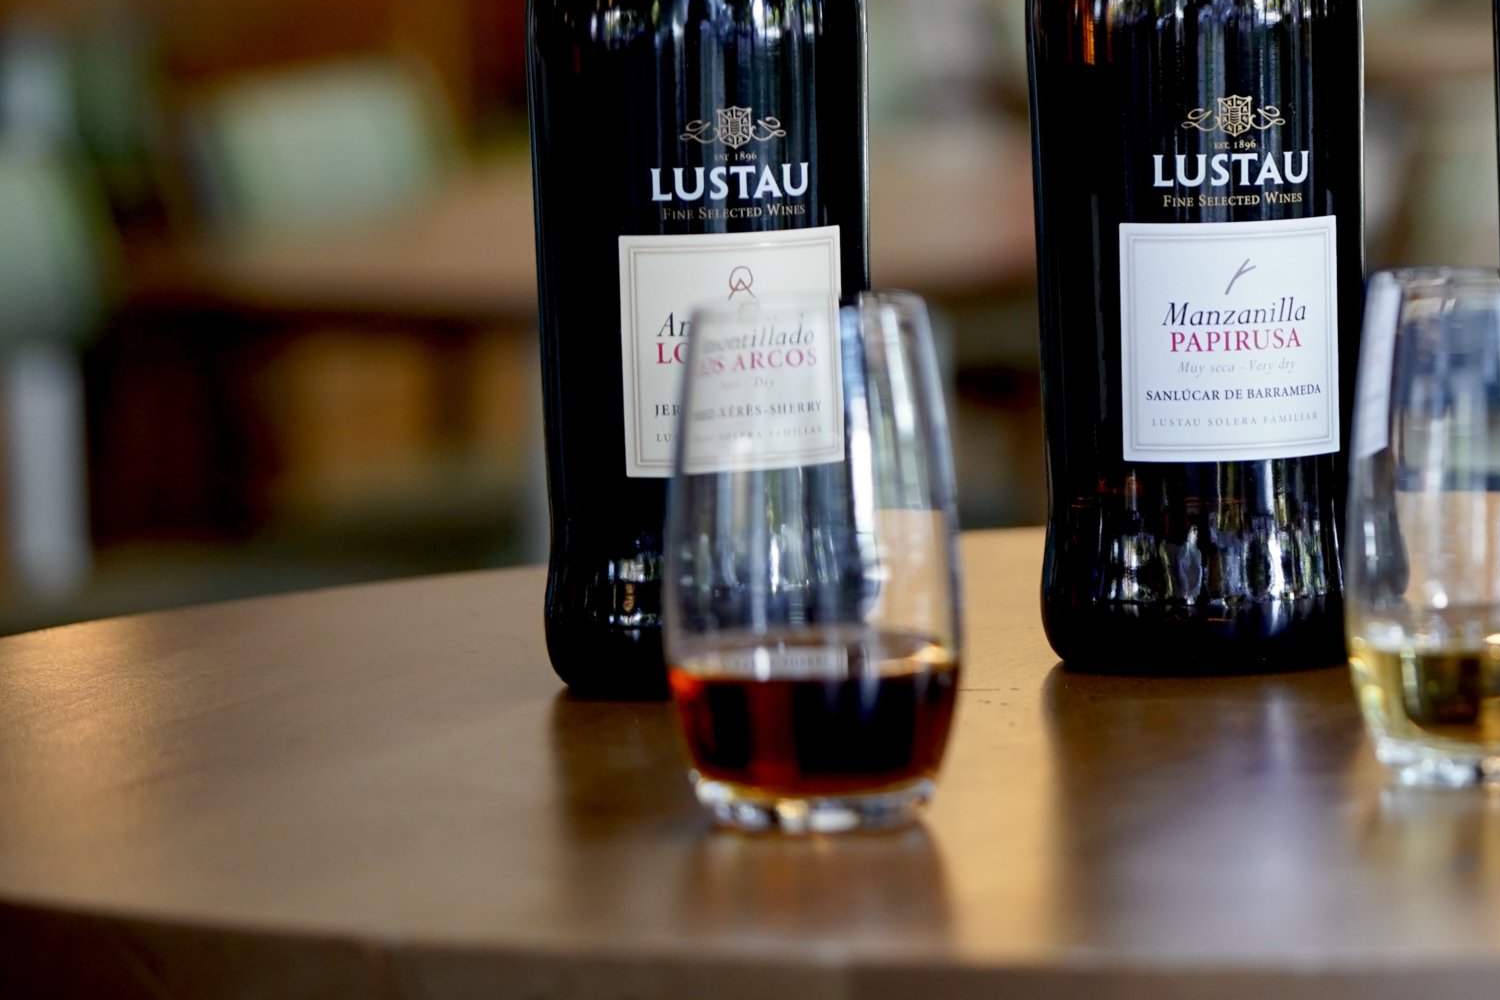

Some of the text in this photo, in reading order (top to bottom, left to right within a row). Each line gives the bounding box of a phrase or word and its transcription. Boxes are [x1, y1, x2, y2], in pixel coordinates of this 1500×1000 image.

[1234, 138, 1256, 150] 1896
[734, 150, 757, 163] 1896
[1152, 150, 1309, 188] LUSTAU
[651, 162, 809, 202] LUSTAU
[1162, 296, 1307, 327] Manzanilla
[1170, 327, 1302, 353] PAPIRUSA
[732, 347, 818, 373] ARCOS
[1177, 360, 1206, 378] Muy
[1146, 383, 1322, 402] SANLÚCAR DE BARRAMEDA
[1152, 411, 1319, 428] LUSTAU SOLERA FAMILIAR
